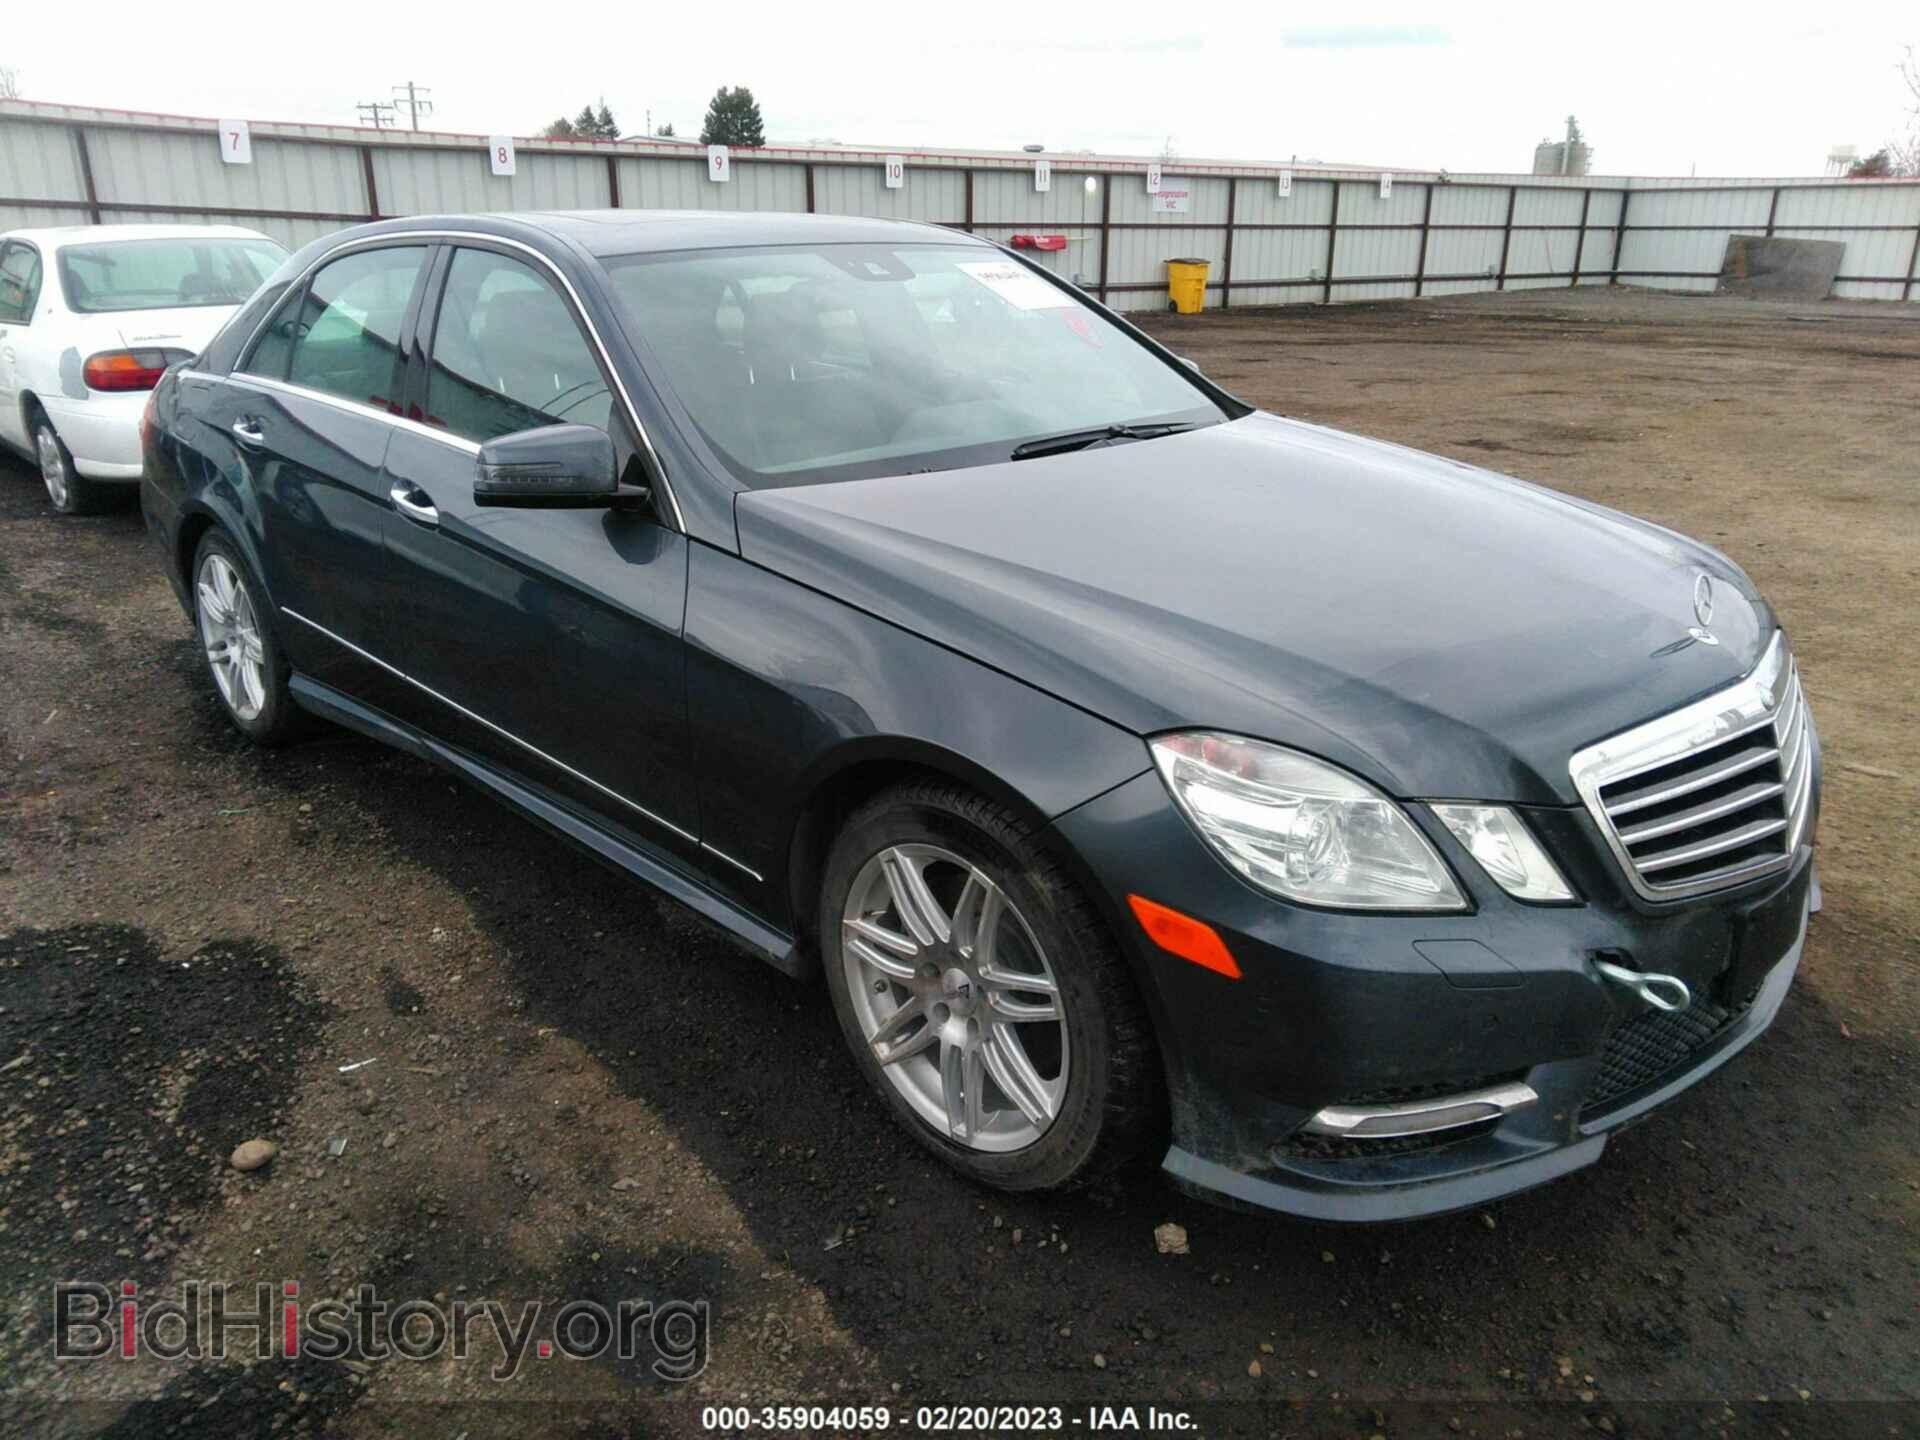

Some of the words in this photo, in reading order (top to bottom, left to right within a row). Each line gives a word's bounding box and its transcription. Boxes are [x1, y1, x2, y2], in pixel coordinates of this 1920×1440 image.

[228, 132, 240, 151] 7
[498, 147, 508, 164] 8
[714, 155, 723, 170] 9
[888, 164, 901, 178] 10
[1039, 168, 1047, 183] 11
[1149, 172, 1160, 185] 12
